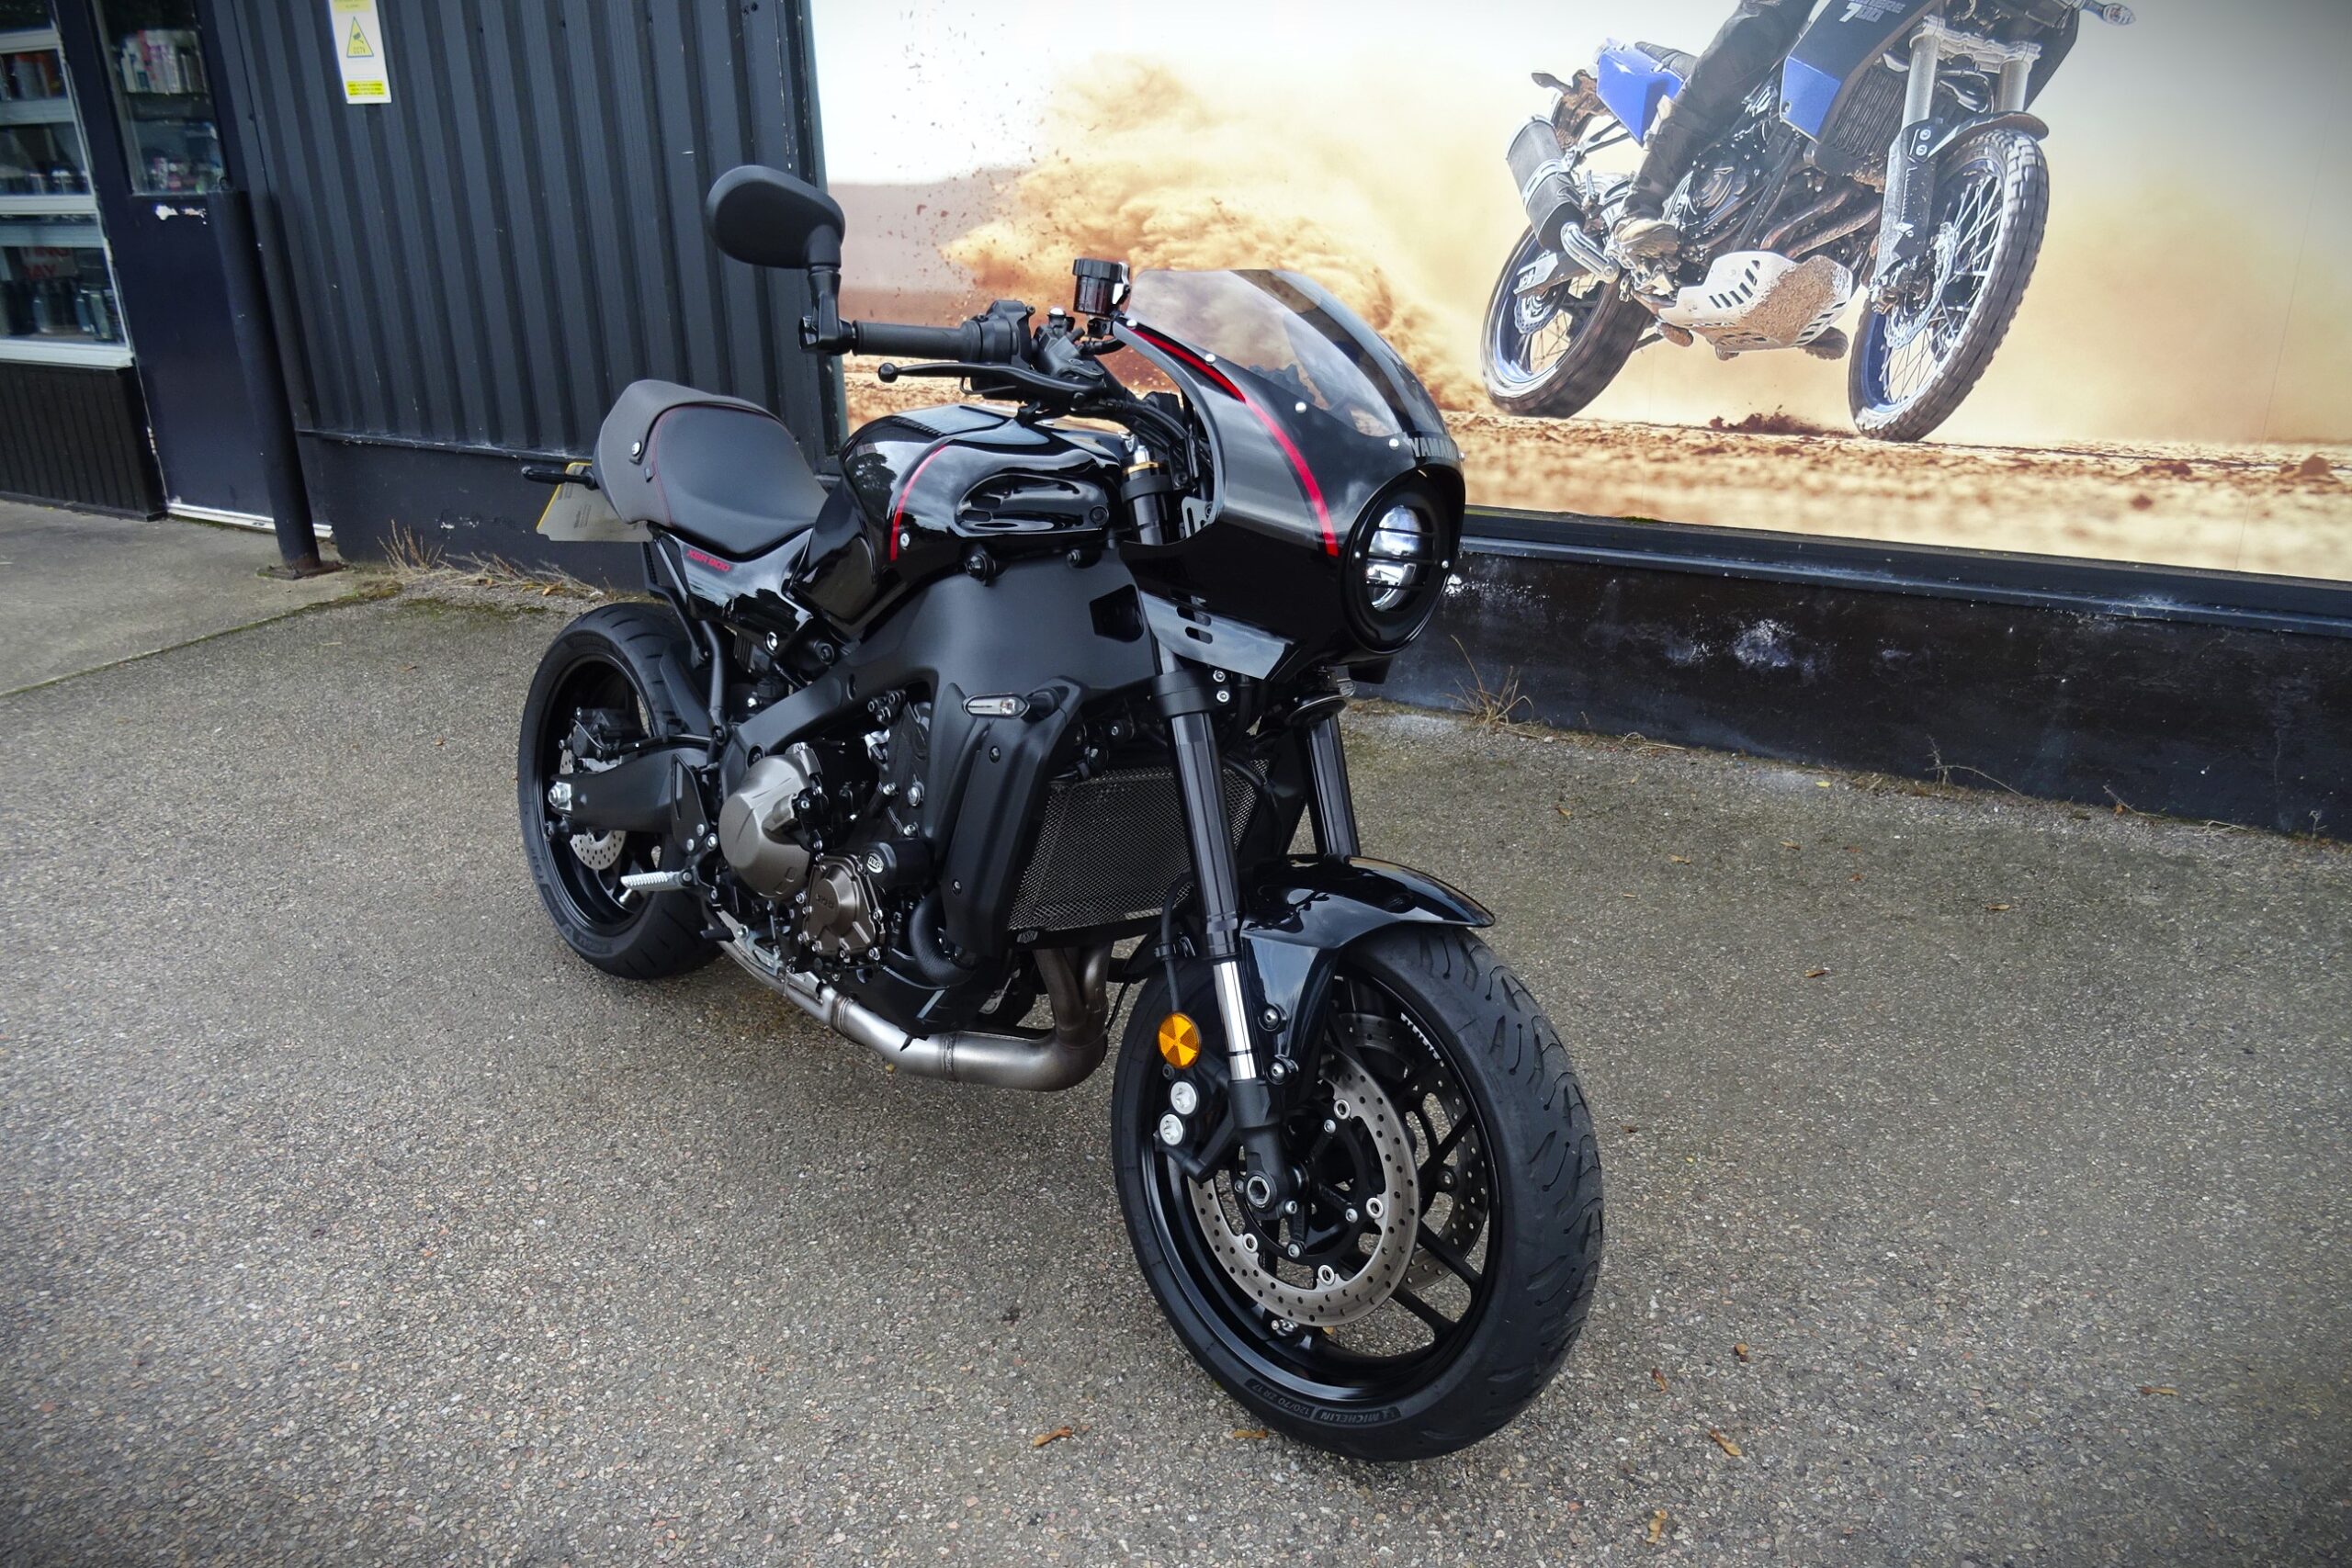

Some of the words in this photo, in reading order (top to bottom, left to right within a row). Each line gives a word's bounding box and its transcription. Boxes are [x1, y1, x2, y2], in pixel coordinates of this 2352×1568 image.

[1838, 2, 1884, 22] 700
[1250, 1382, 1263, 1393] 17
[1264, 1389, 1278, 1400] ZR
[1279, 1396, 1310, 1415] 120/70
[1320, 1411, 1380, 1424] MICHELIN
